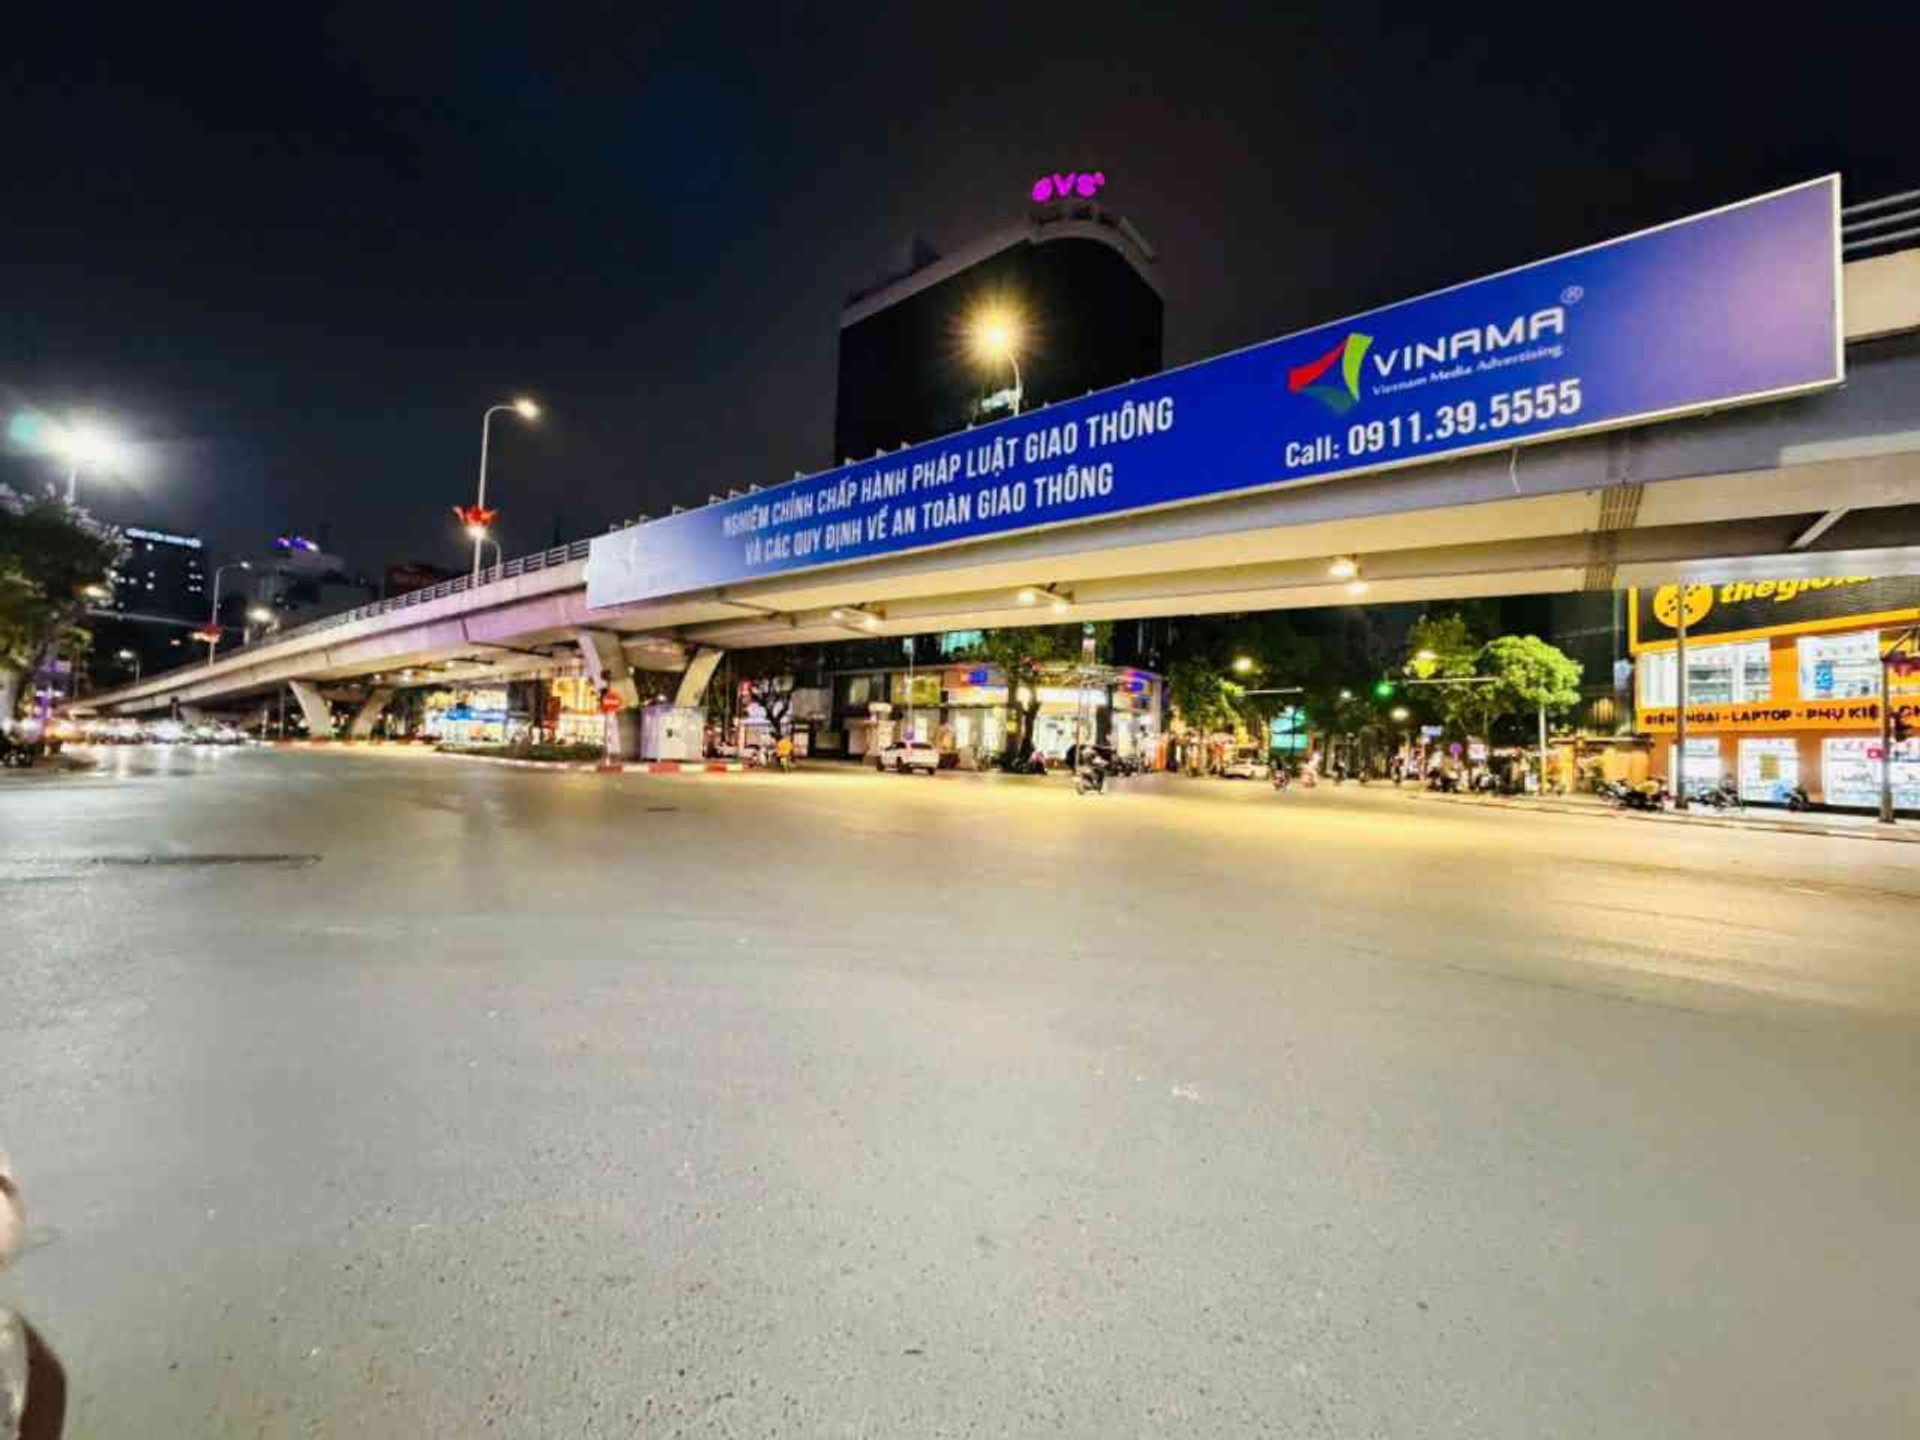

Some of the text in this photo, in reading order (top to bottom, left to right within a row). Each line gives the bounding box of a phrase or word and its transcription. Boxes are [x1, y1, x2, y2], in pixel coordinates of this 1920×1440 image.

[1373, 306, 1565, 377] VINAMA
[1428, 363, 1473, 384] Media
[818, 475, 857, 517] CHẤP
[861, 468, 907, 503] HÀNH
[911, 451, 961, 490] PHÁP
[965, 436, 1020, 478] LUẬT
[1025, 422, 1077, 463] GIAO
[1086, 396, 1174, 448] THÔNG
[1285, 378, 1582, 468] Call: 0911.39.5555
[745, 462, 1114, 565] VÀ CÁC QUY ĐỊNH VỀ AN TOÀN GIAO THÔNG
[1731, 709, 1792, 722] LAPTOP
